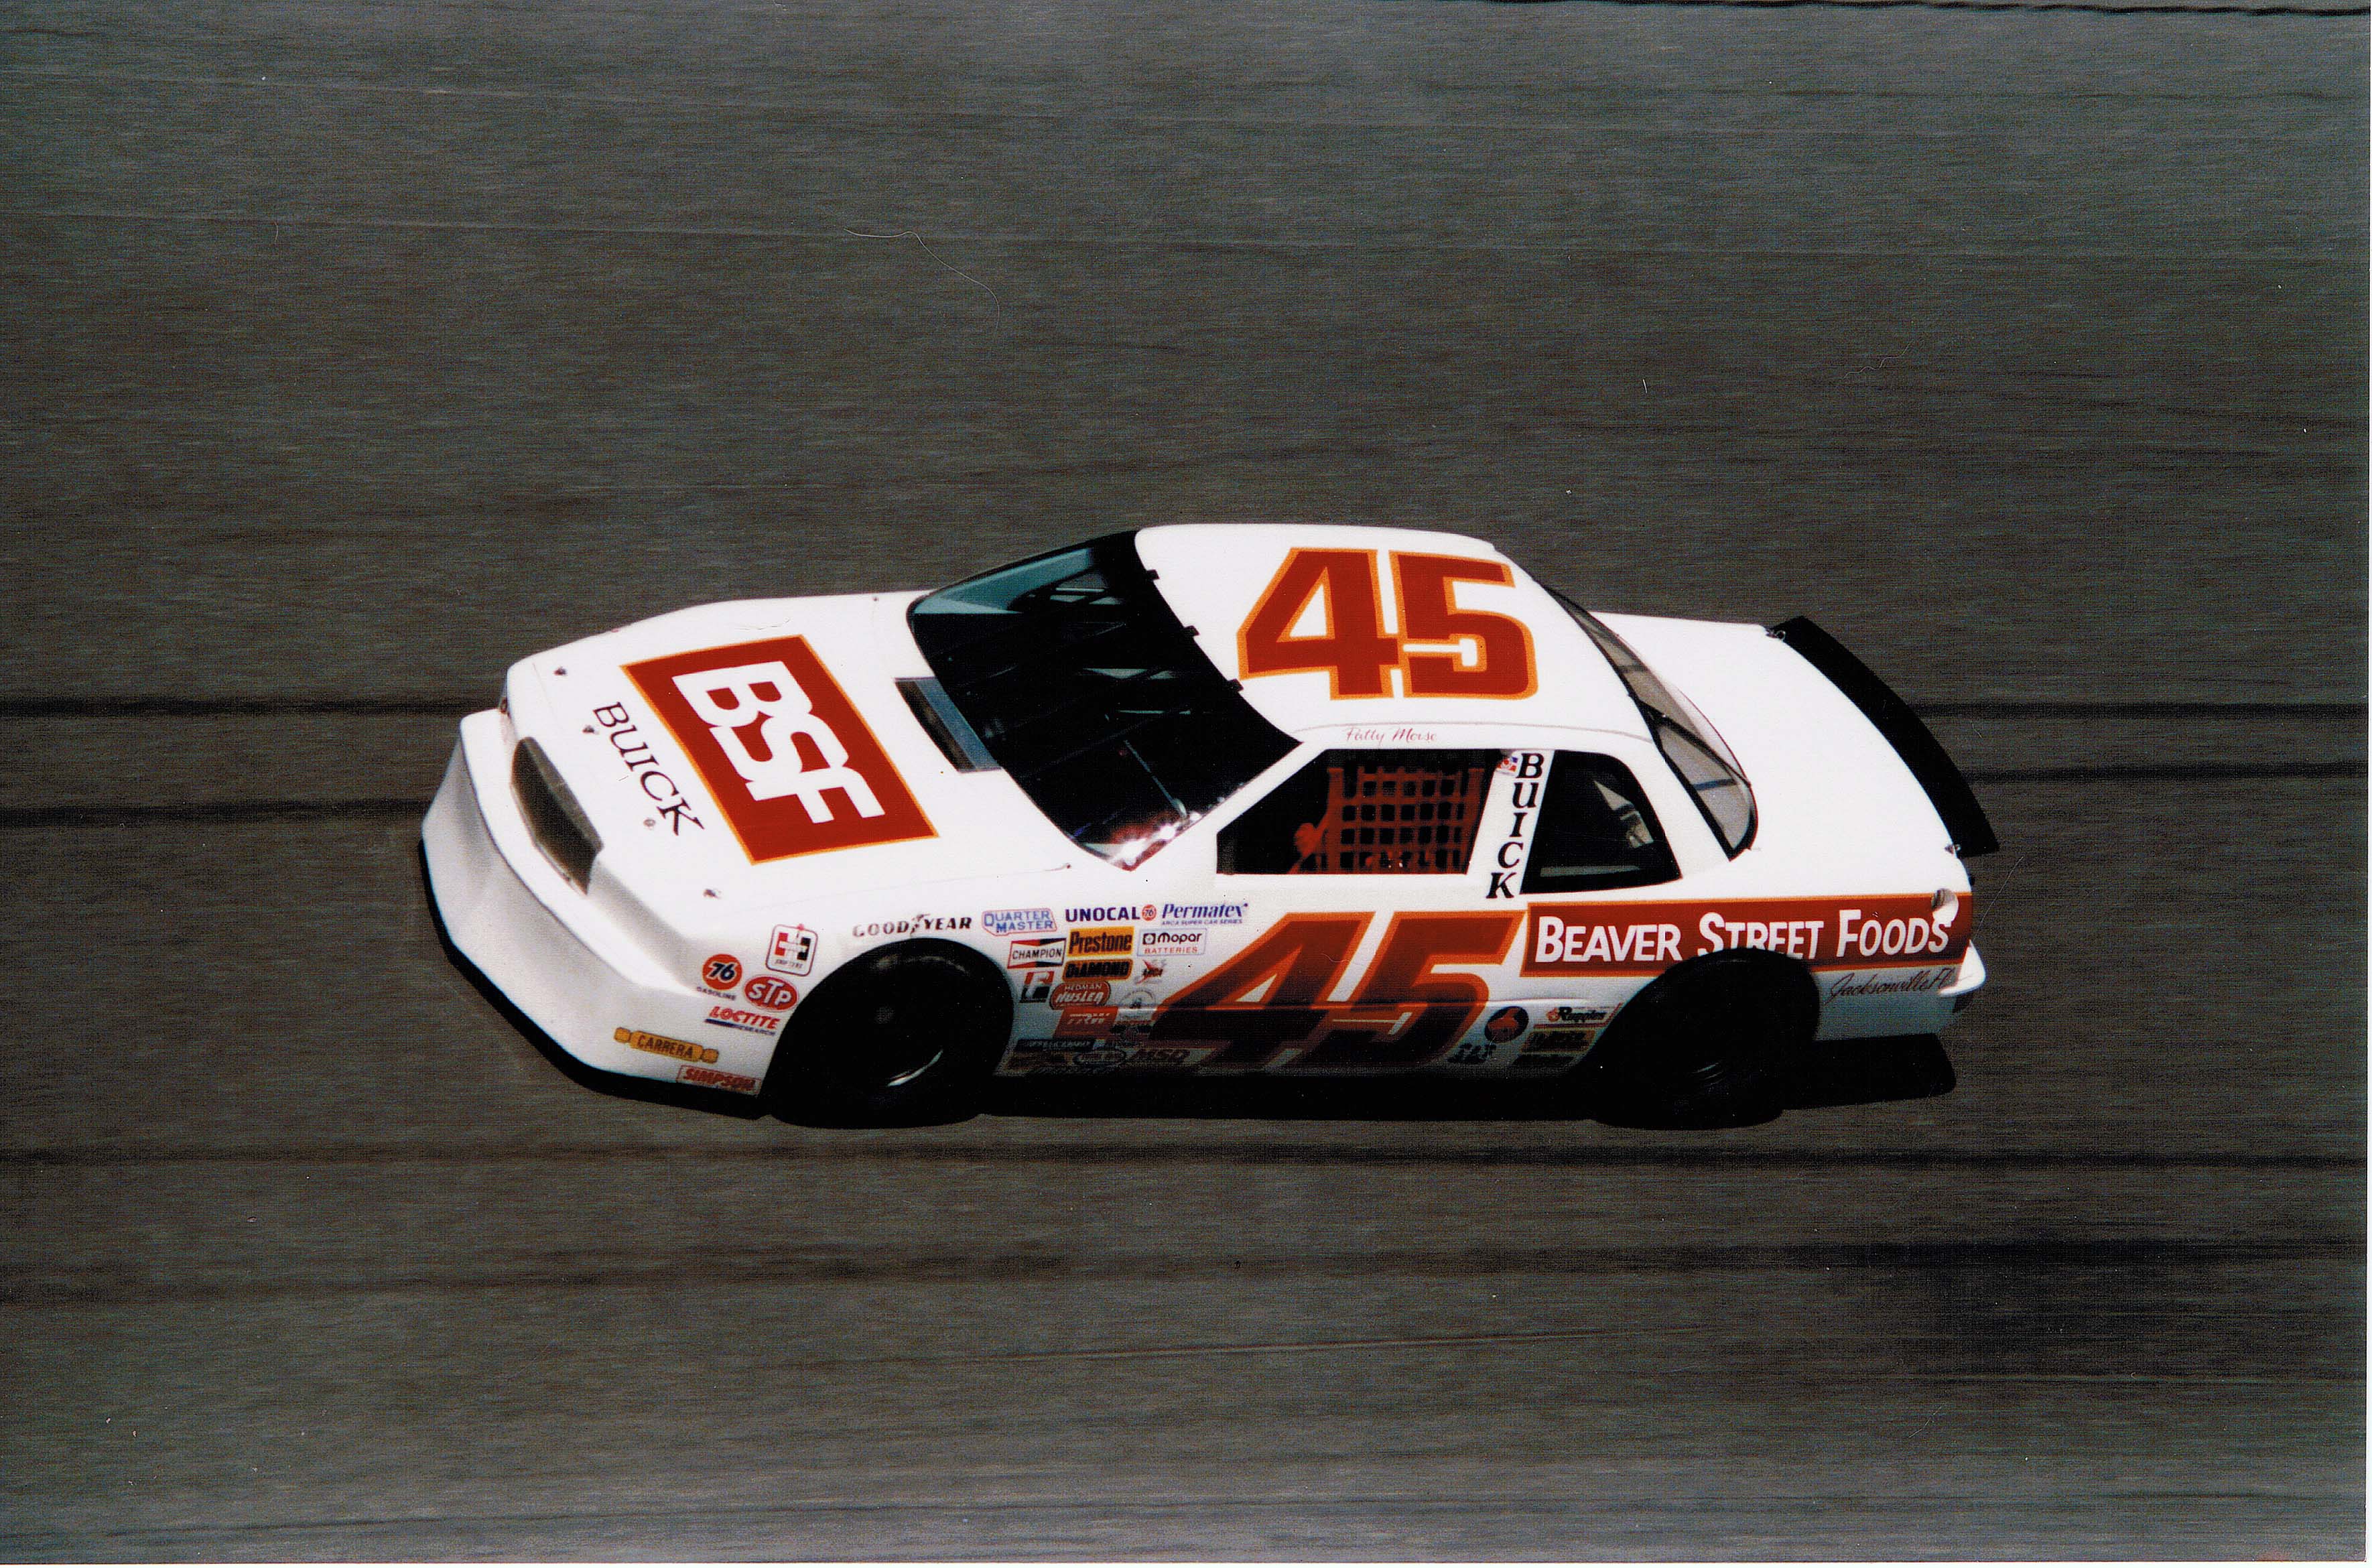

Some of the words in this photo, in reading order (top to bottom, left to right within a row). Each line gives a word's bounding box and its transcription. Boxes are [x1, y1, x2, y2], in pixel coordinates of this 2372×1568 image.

[1236, 547, 1538, 701] 45
[671, 661, 885, 824] BSF
[1346, 726, 1385, 746] Patty
[593, 702, 704, 836] BUICK
[1486, 753, 1544, 899] BUICK
[984, 911, 1050, 926] QUARTER
[1065, 907, 1140, 923] UNOCAL
[1144, 908, 1155, 917] 76
[1162, 903, 1244, 919] Permatex
[996, 920, 1054, 933] MASTER
[1534, 916, 1683, 963] BEAVER
[1697, 912, 1824, 960] STREET
[1836, 909, 1952, 958] FOODS
[1068, 930, 1132, 954] Prestone
[1144, 946, 1198, 955] BATTERIES
[1012, 948, 1063, 960] CHAMPION
[707, 962, 736, 982] 76
[696, 986, 736, 1001] GASOLINE
[748, 979, 792, 1006] STP
[1148, 910, 1526, 1070] 45
[709, 1006, 781, 1030] LOCTITE
[637, 1035, 694, 1058] CARRERA
[684, 1068, 756, 1092] SIMPSON
